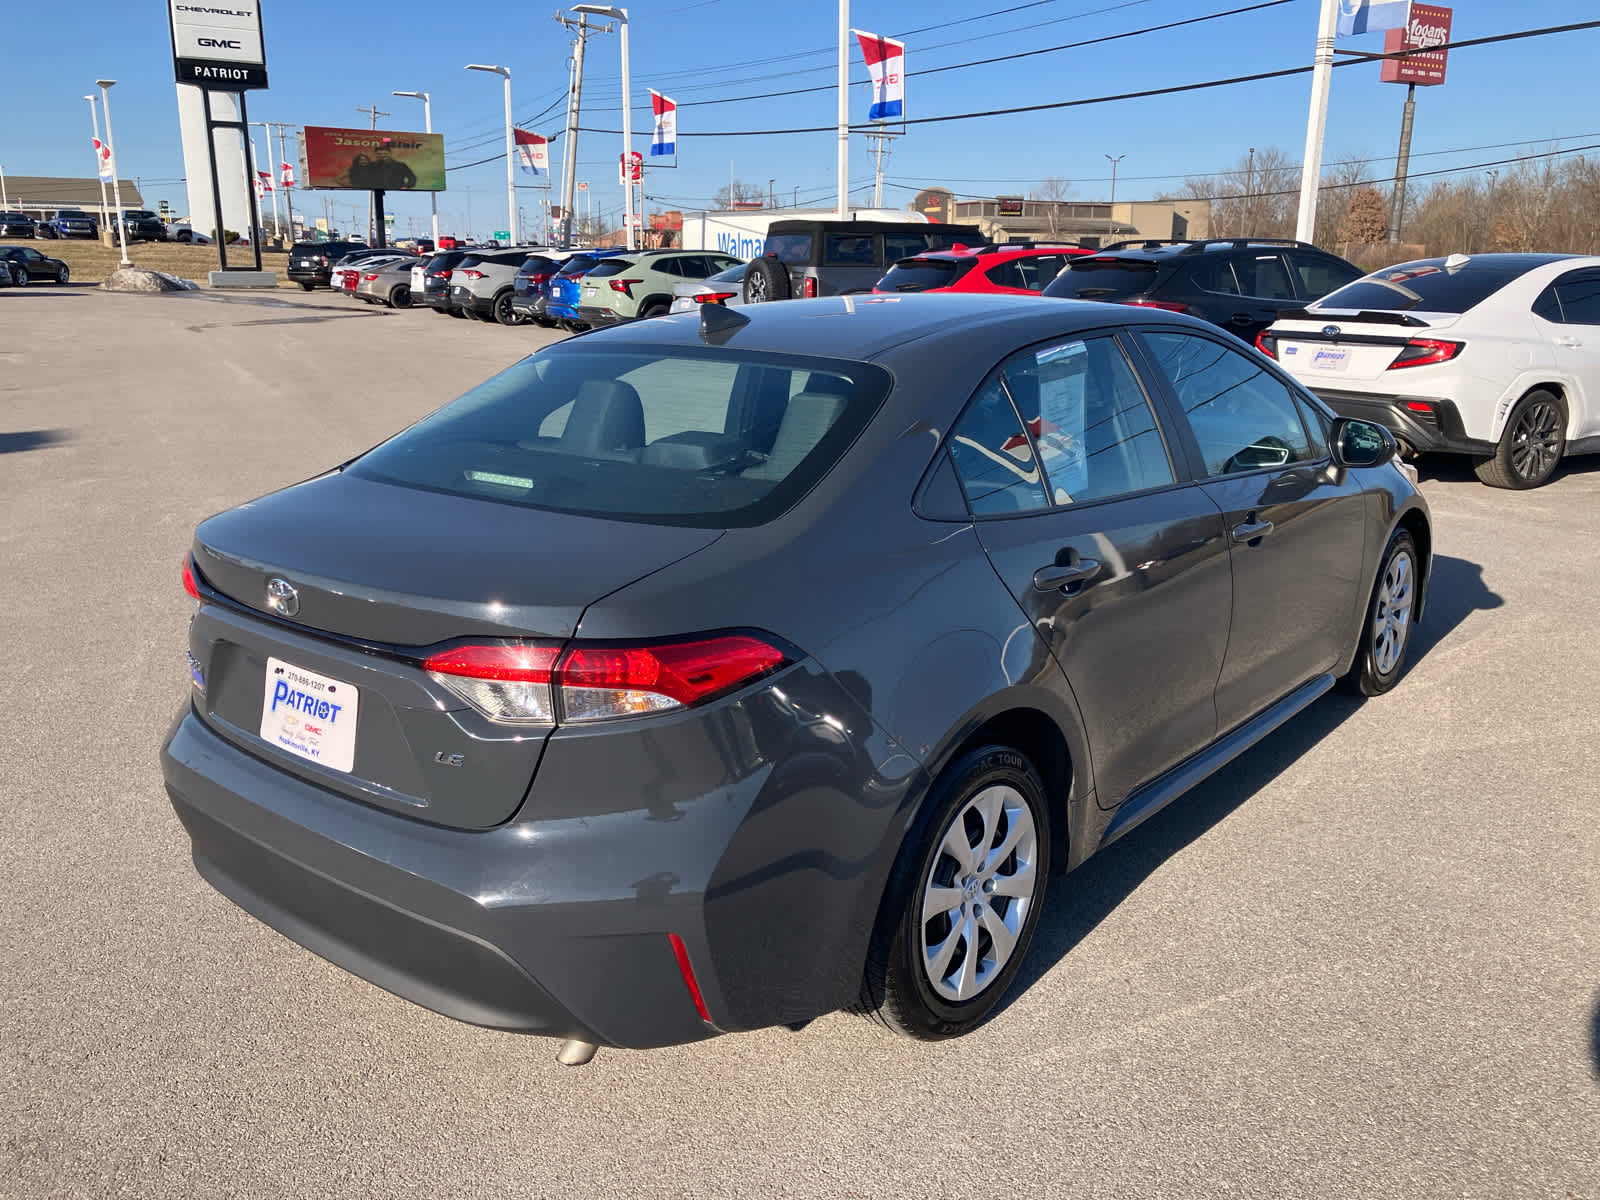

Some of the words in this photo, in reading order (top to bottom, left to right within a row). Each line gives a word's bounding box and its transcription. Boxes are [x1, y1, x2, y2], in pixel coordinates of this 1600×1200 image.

[176, 5, 253, 17] CHEVROLET
[197, 38, 241, 49] GMC
[194, 66, 249, 79] PATRIOT
[334, 137, 381, 148] Jason
[271, 680, 342, 723] PATRIOT
[434, 751, 465, 767] LE
